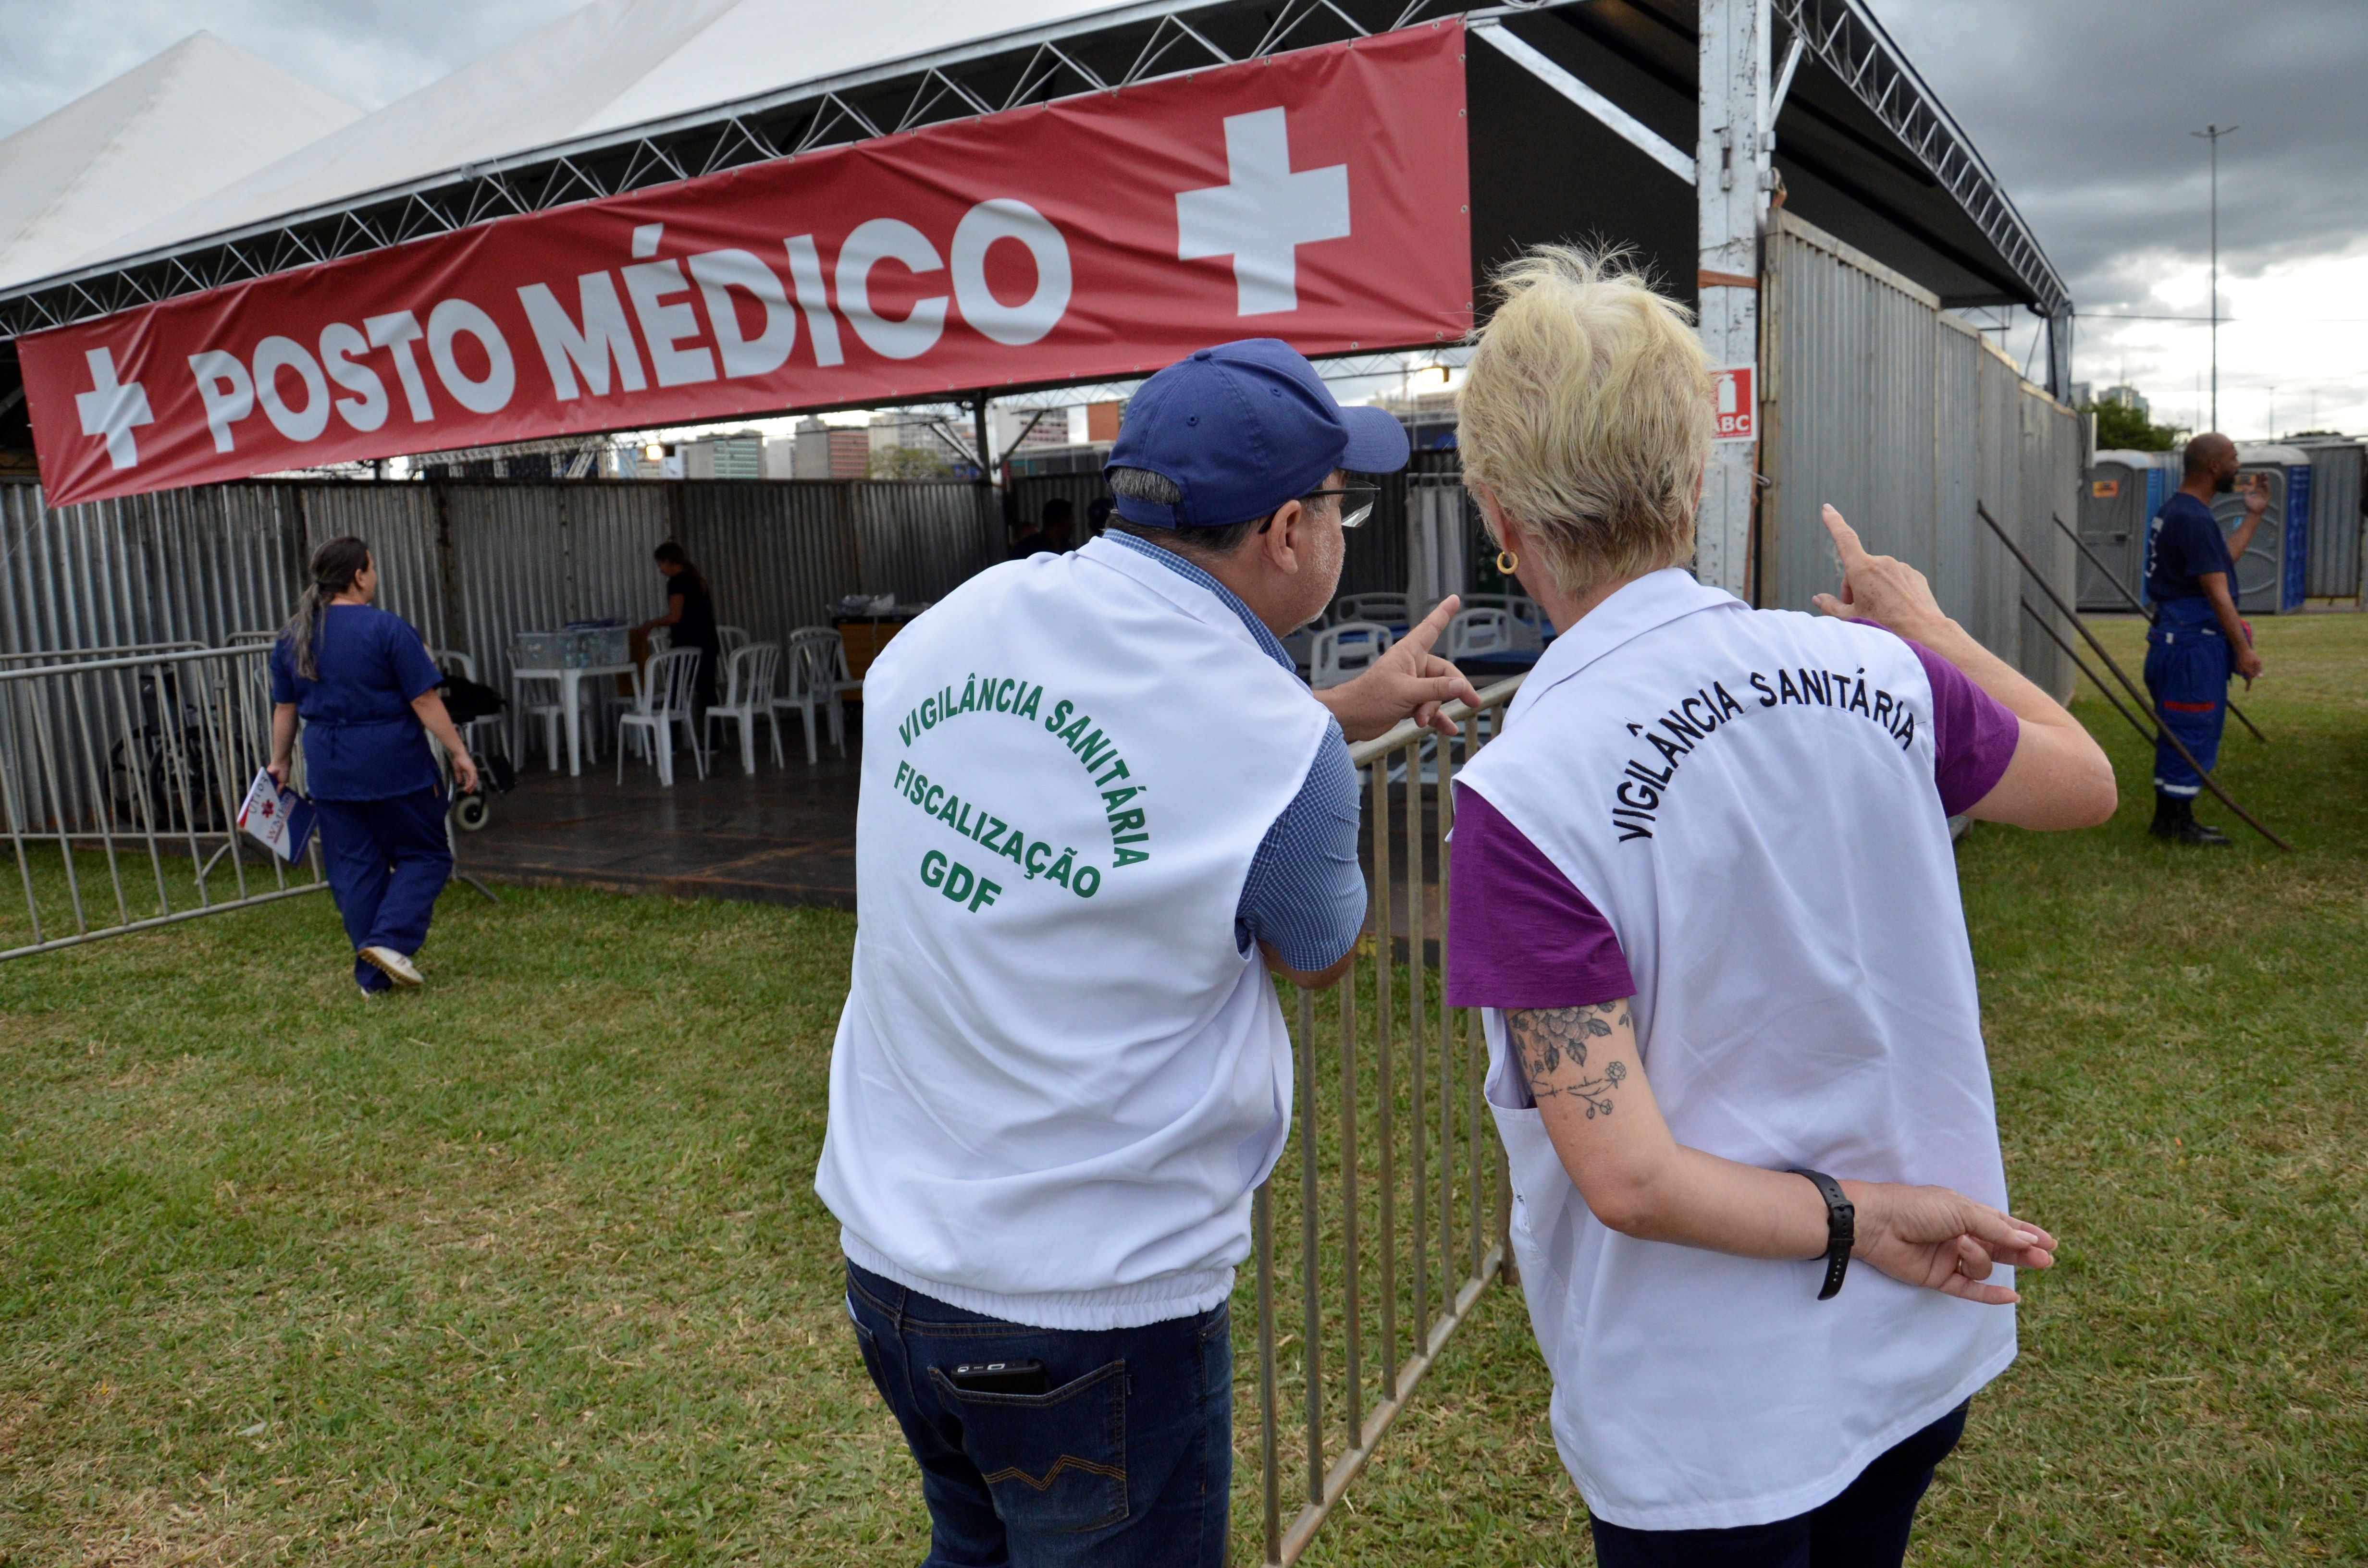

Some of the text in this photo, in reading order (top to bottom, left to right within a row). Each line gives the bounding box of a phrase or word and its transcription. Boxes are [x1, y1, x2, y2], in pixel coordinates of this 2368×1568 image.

[188, 197, 1072, 453] POSTO MÉDICO
[894, 760, 1100, 898] FISCALIZAÇÃO
[899, 673, 1149, 868] VIGILÂNCIA SANITÁRIA
[1612, 667, 1914, 843] VIGILÂNCIA SANITÁRIA
[920, 850, 1002, 913] GDF
